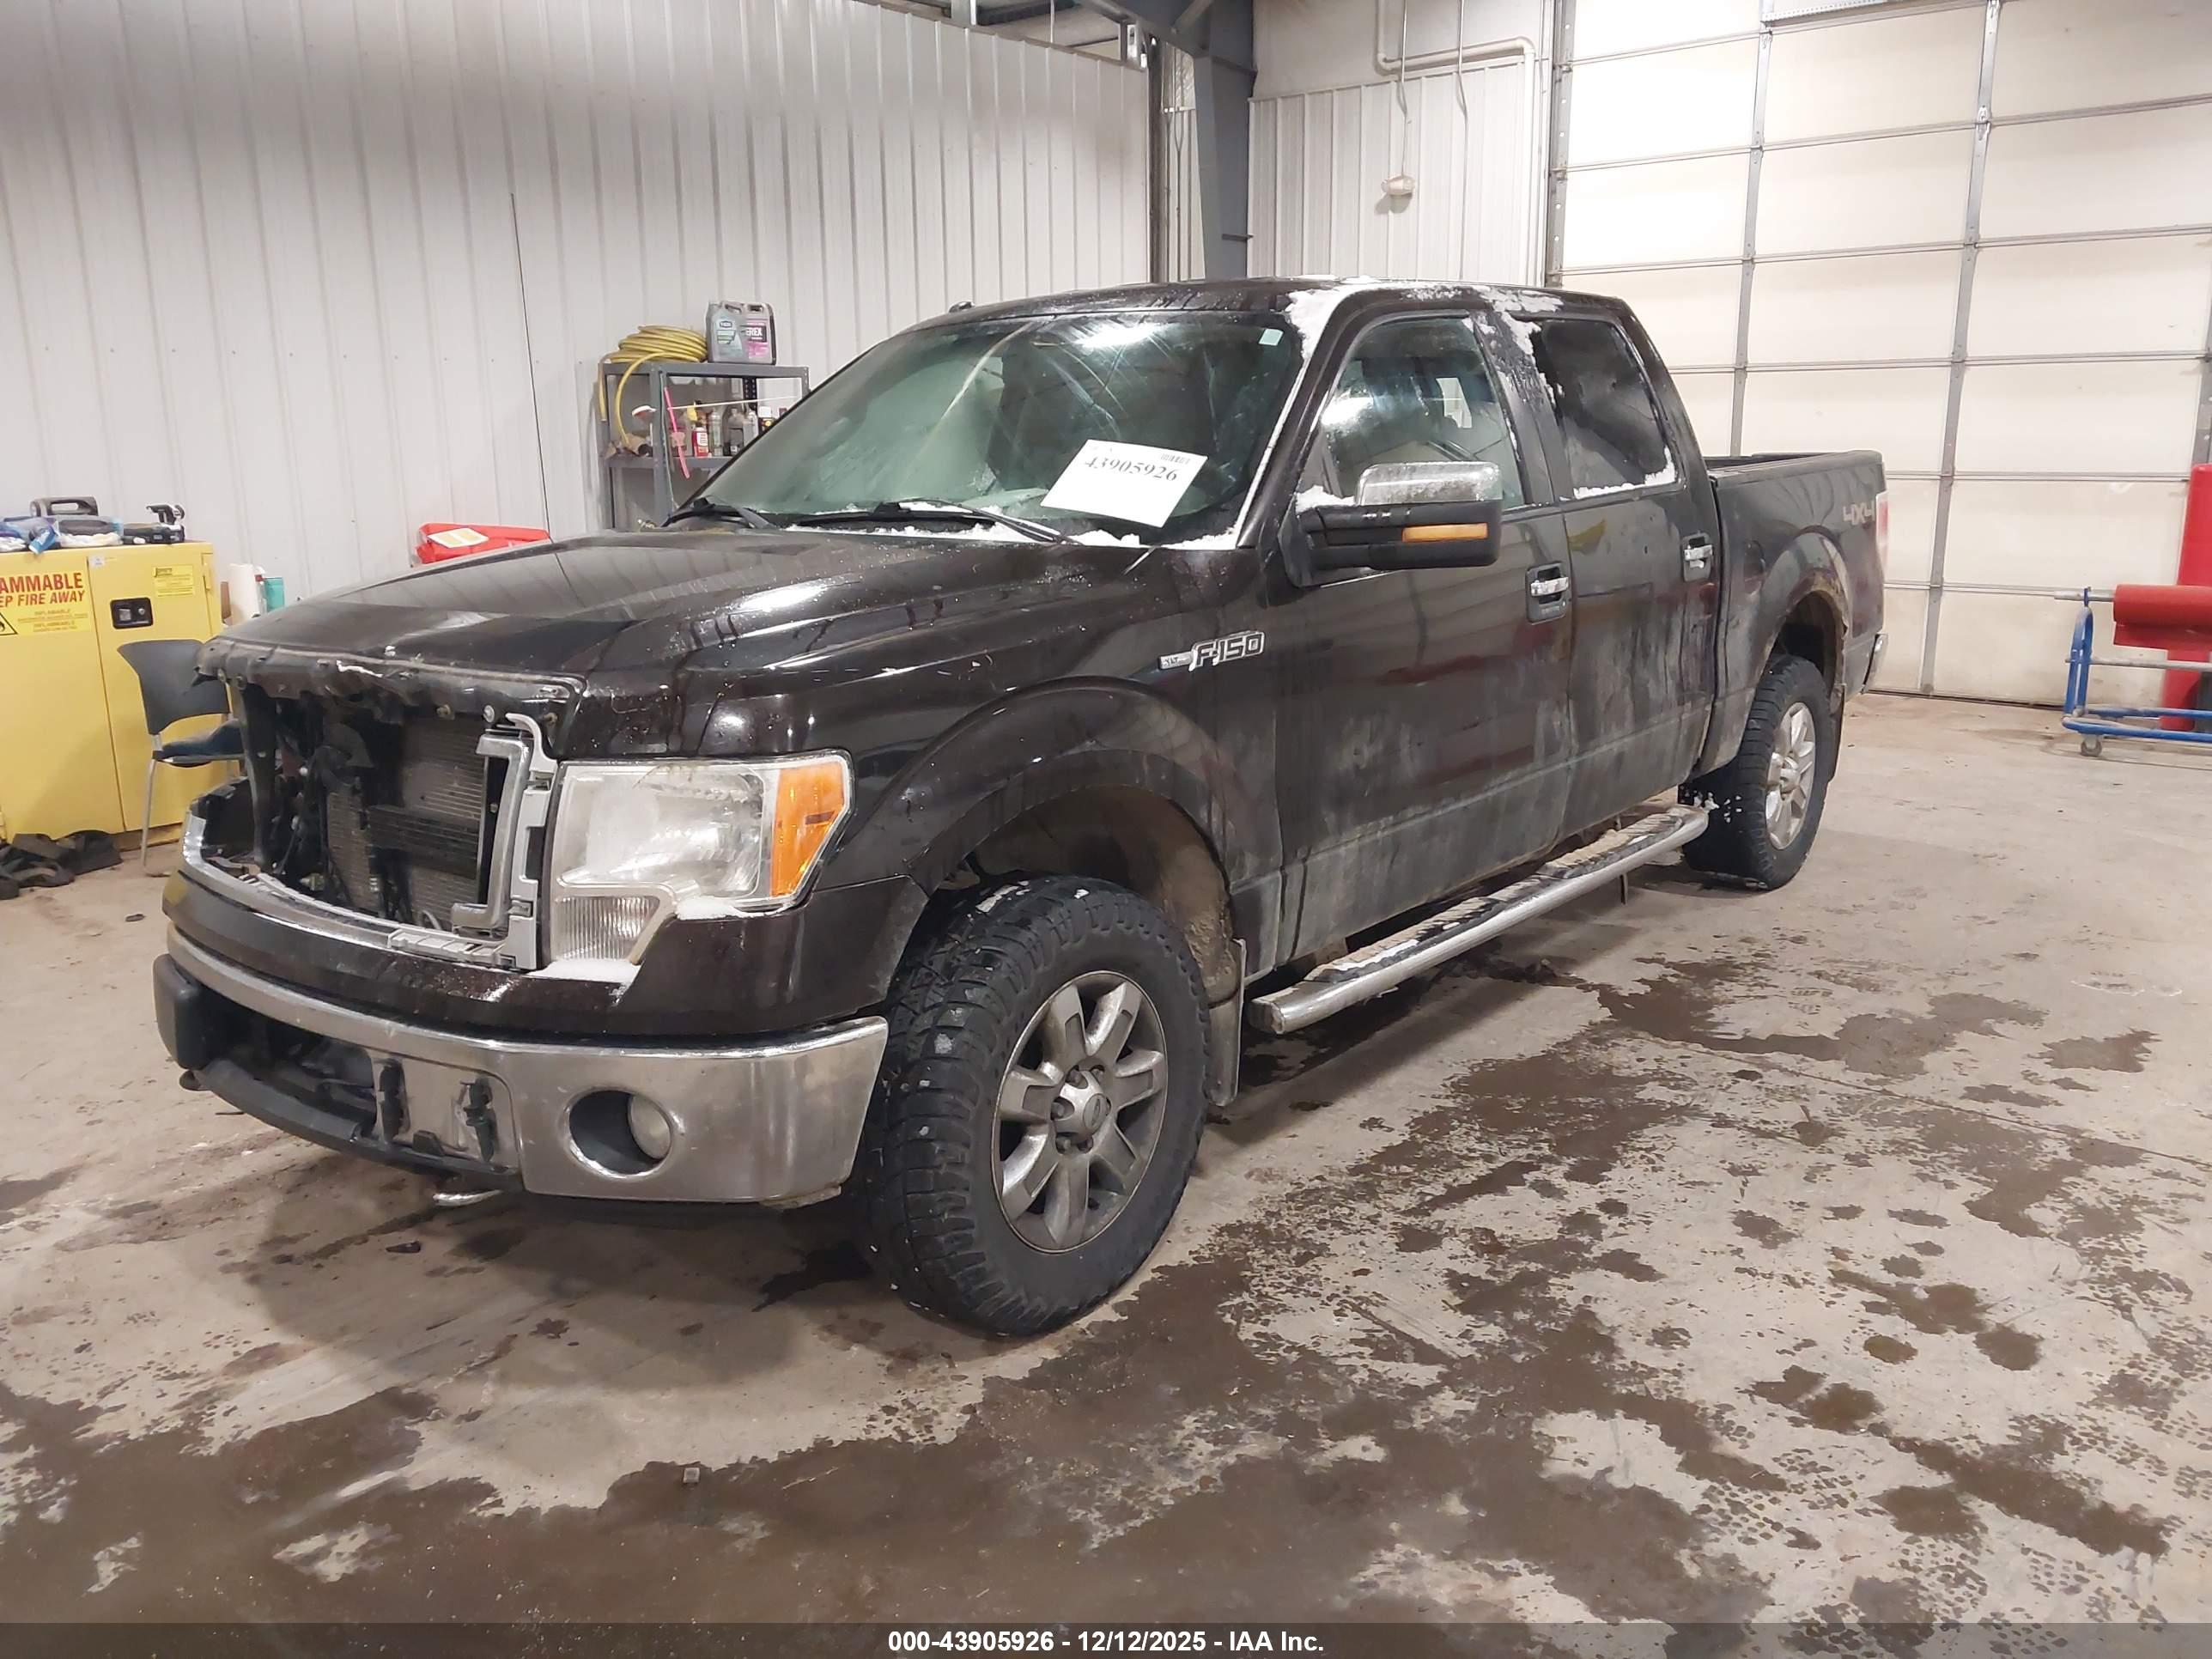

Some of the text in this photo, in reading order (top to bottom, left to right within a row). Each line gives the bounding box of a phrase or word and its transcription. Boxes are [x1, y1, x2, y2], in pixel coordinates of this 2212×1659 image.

[1085, 456, 1181, 481] 43905926
[17, 592, 46, 606] FIRE
[50, 590, 85, 605] AWAY
